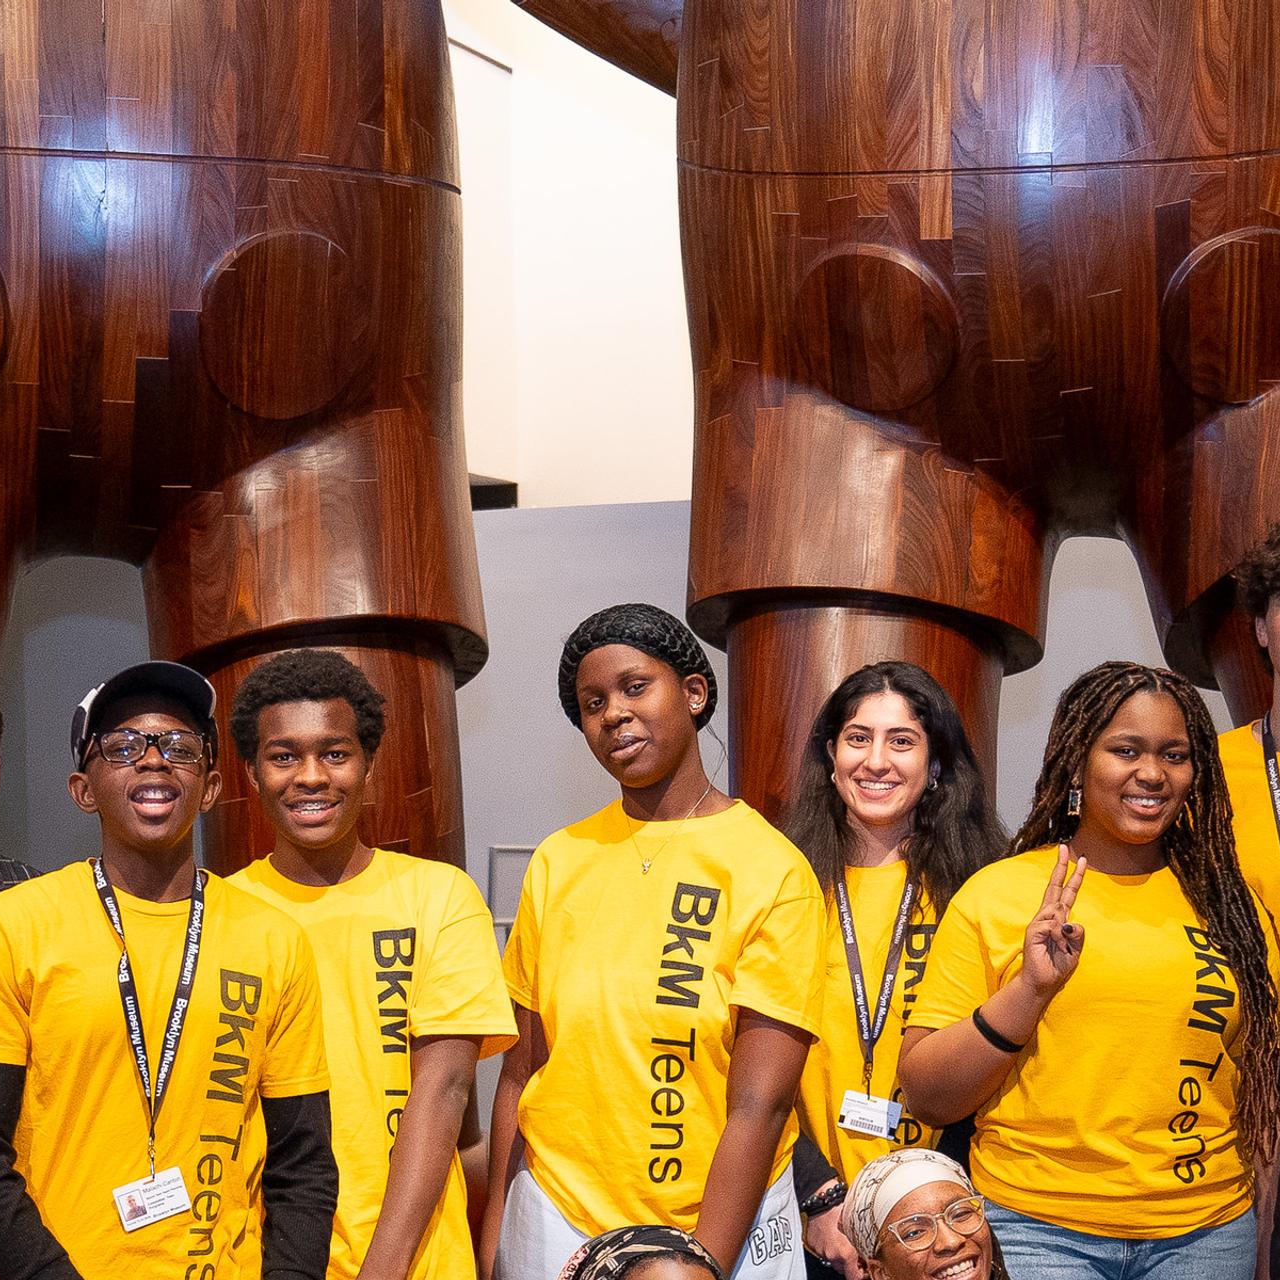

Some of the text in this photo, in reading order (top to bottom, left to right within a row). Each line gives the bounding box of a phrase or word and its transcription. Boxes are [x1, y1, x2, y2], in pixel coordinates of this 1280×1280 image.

[187, 901, 204, 943] Brooklyn
[838, 883, 854, 944] Brooklyn Museum
[894, 913, 907, 944] Museum
[181, 942, 200, 986] Museum
[372, 927, 417, 1055] BkM
[205, 968, 263, 1105] BkM
[648, 882, 722, 1184] BkM Teens
[855, 974, 869, 1040] Brooklyn Museum
[873, 974, 893, 1039] Brooklyn Museum
[125, 996, 151, 1098] Brooklyn Museum
[155, 998, 188, 1097] Brooklyn Museum
[1168, 924, 1236, 1184] BkM Teens
[748, 1215, 792, 1267] GAP
